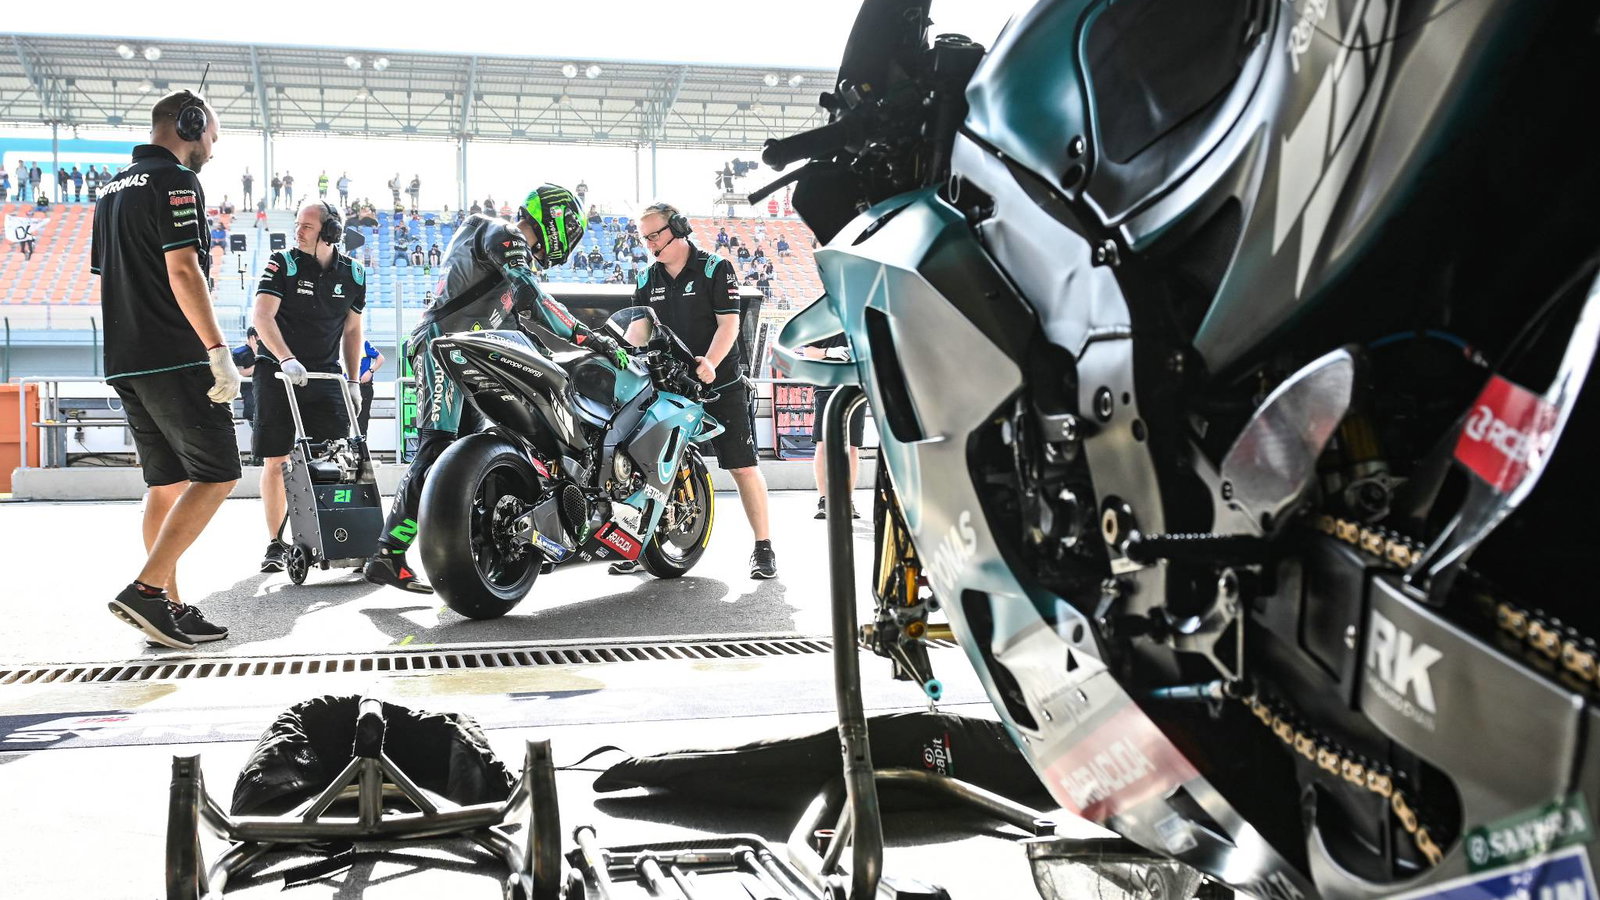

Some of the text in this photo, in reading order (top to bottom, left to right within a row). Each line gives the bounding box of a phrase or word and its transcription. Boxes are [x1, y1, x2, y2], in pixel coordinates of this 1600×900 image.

[500, 356, 544, 378] europe energy
[431, 362, 445, 422] TRONAS
[334, 490, 352, 503] 21
[644, 484, 667, 507] PETRON
[1366, 609, 1443, 714] RK
[933, 738, 947, 776] capit
